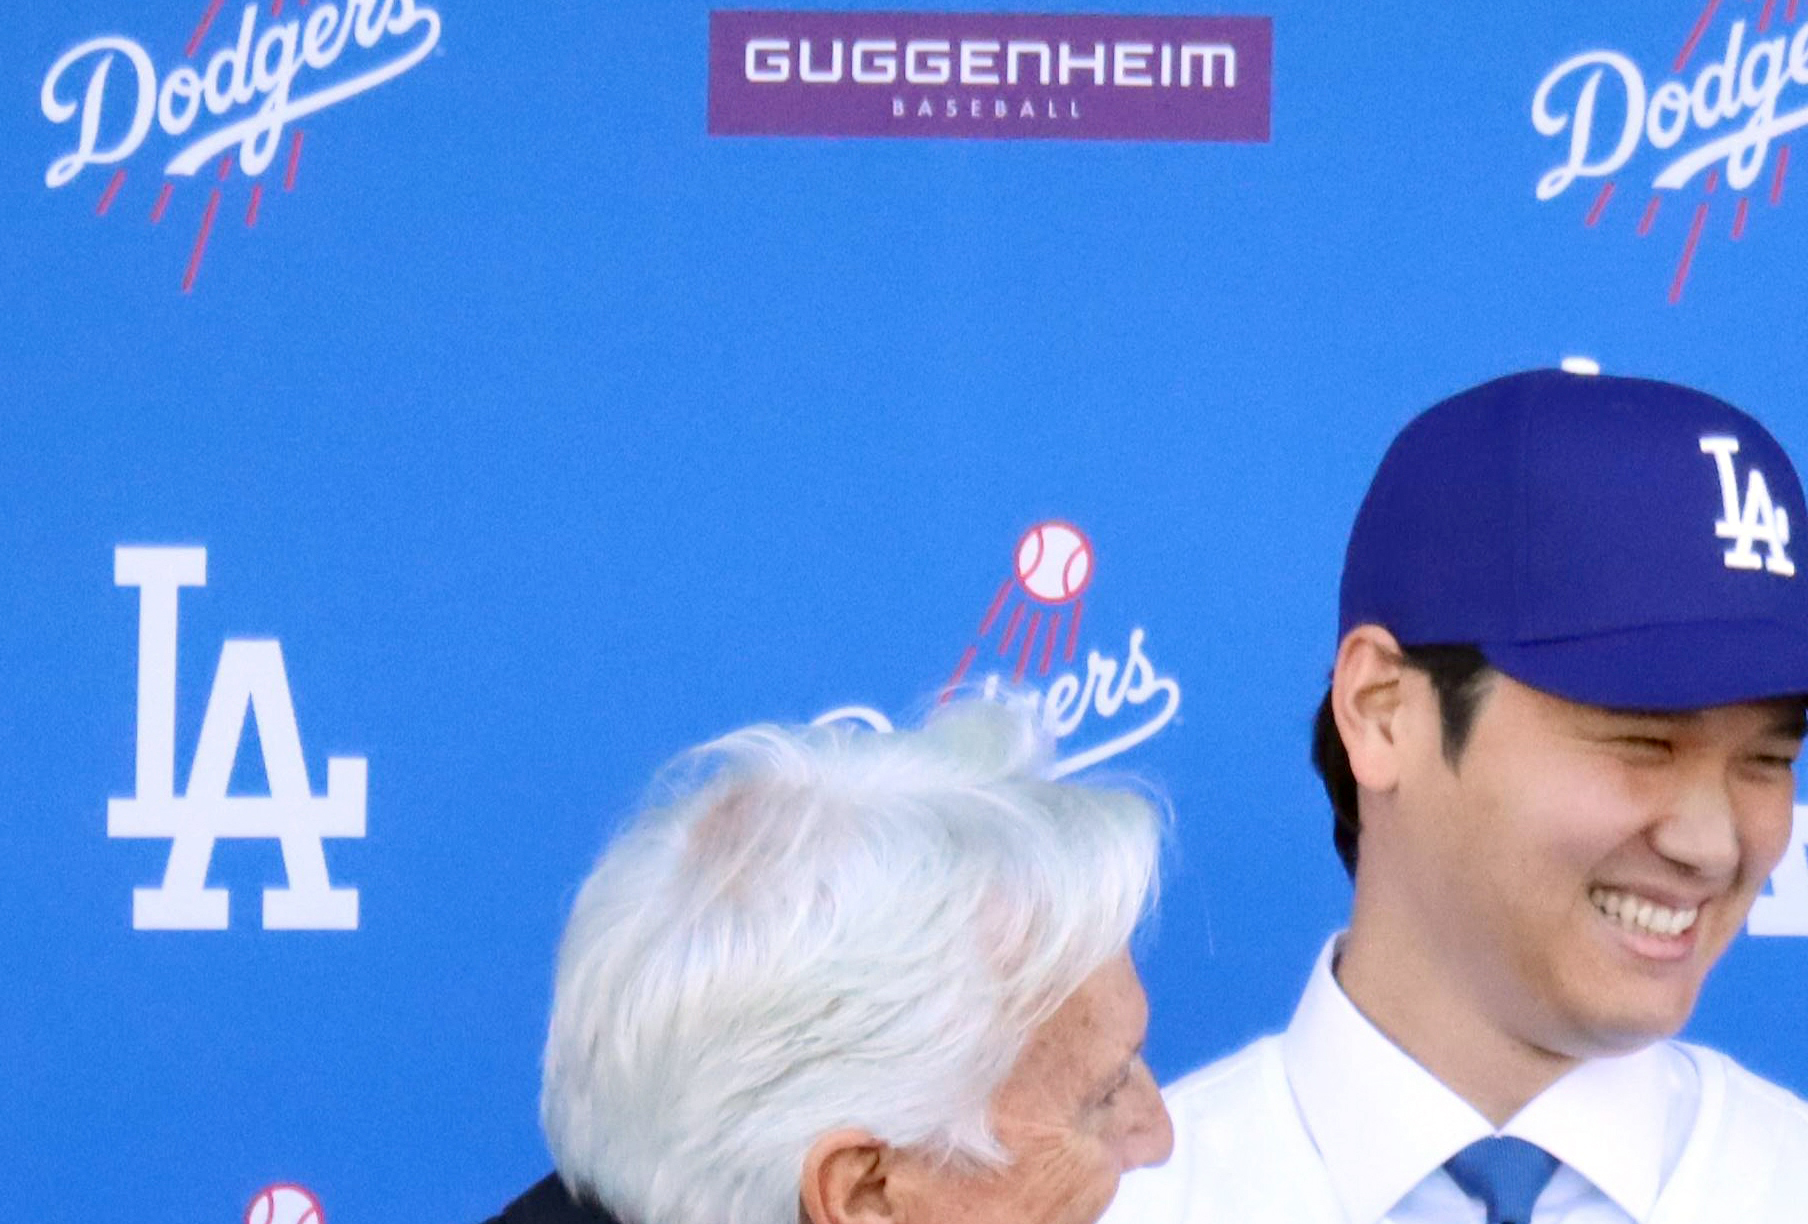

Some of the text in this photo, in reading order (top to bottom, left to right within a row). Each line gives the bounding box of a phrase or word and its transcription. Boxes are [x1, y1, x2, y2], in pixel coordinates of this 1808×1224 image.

[744, 38, 1237, 88] GUGGENHEIM
[892, 98, 1082, 119] BASEBALL
[1699, 436, 1795, 577] LA
[106, 545, 369, 931] LA
